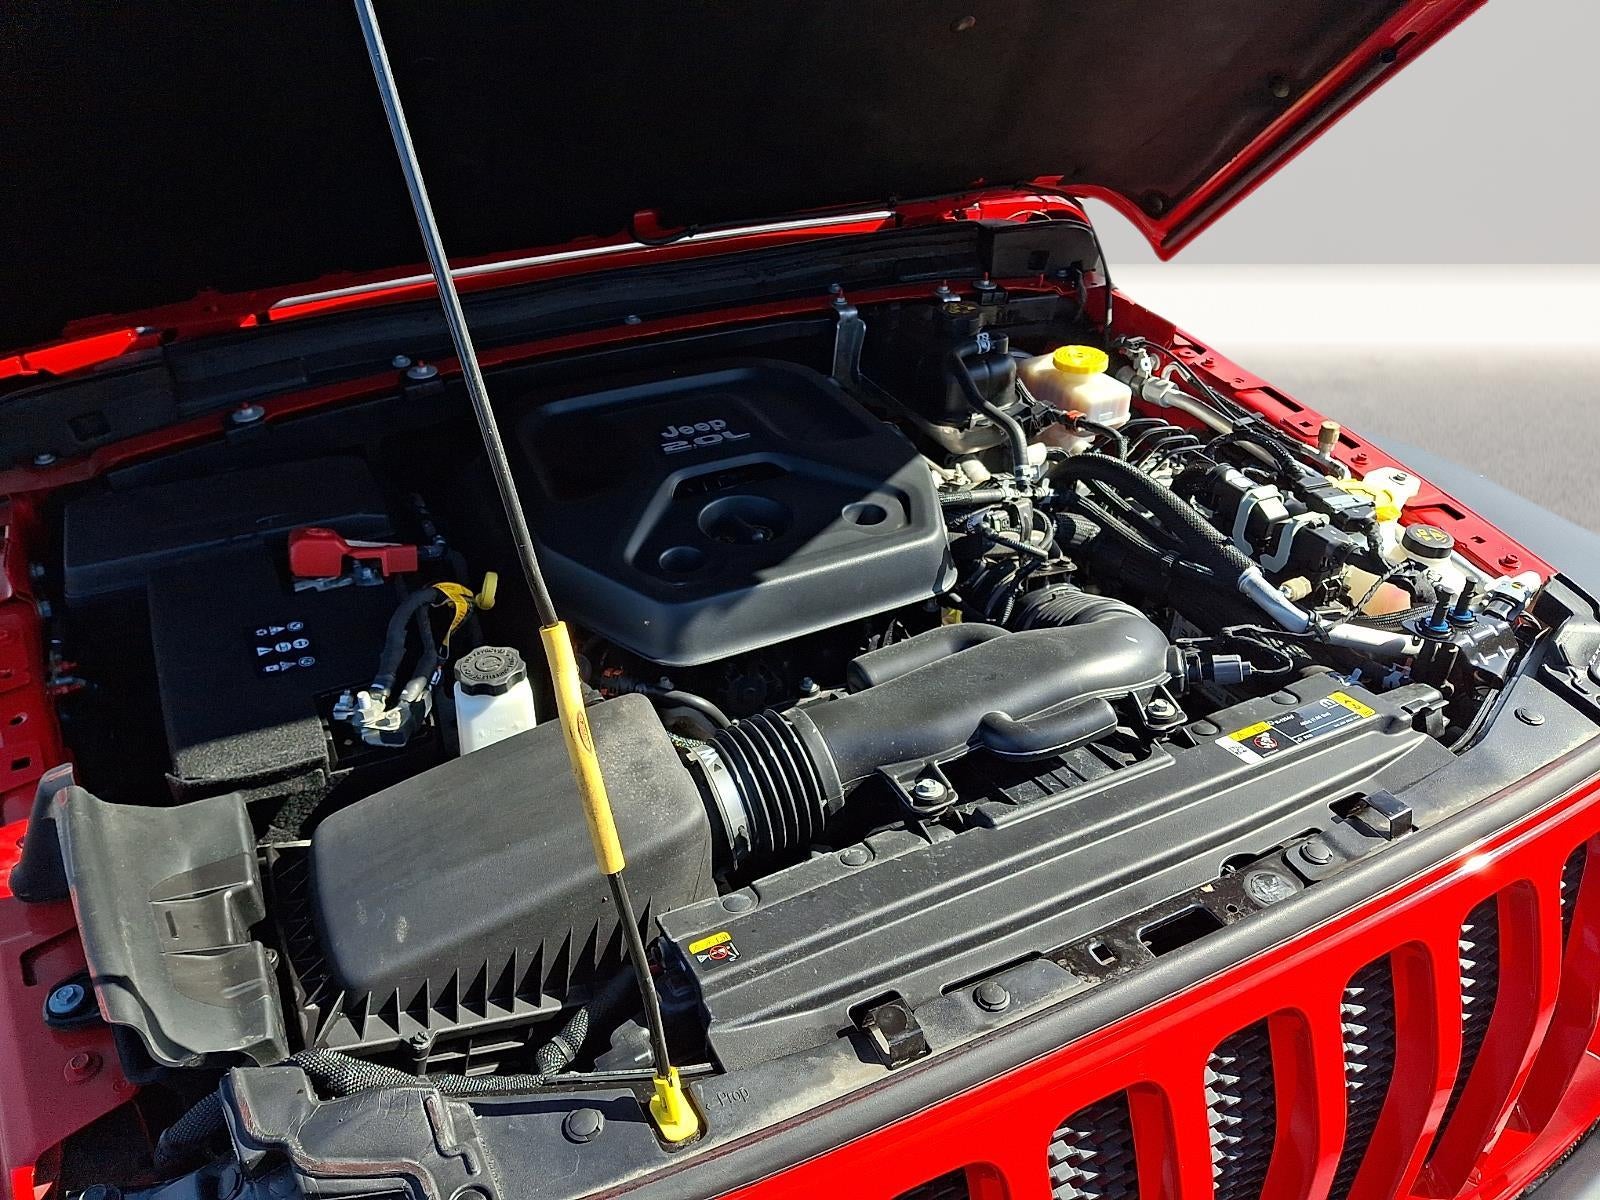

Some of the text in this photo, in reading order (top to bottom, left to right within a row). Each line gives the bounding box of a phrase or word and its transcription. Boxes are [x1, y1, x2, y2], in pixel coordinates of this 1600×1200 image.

[660, 419, 727, 438] Jeep
[660, 432, 751, 455] 2.0L
[716, 1087, 750, 1107] Prop
